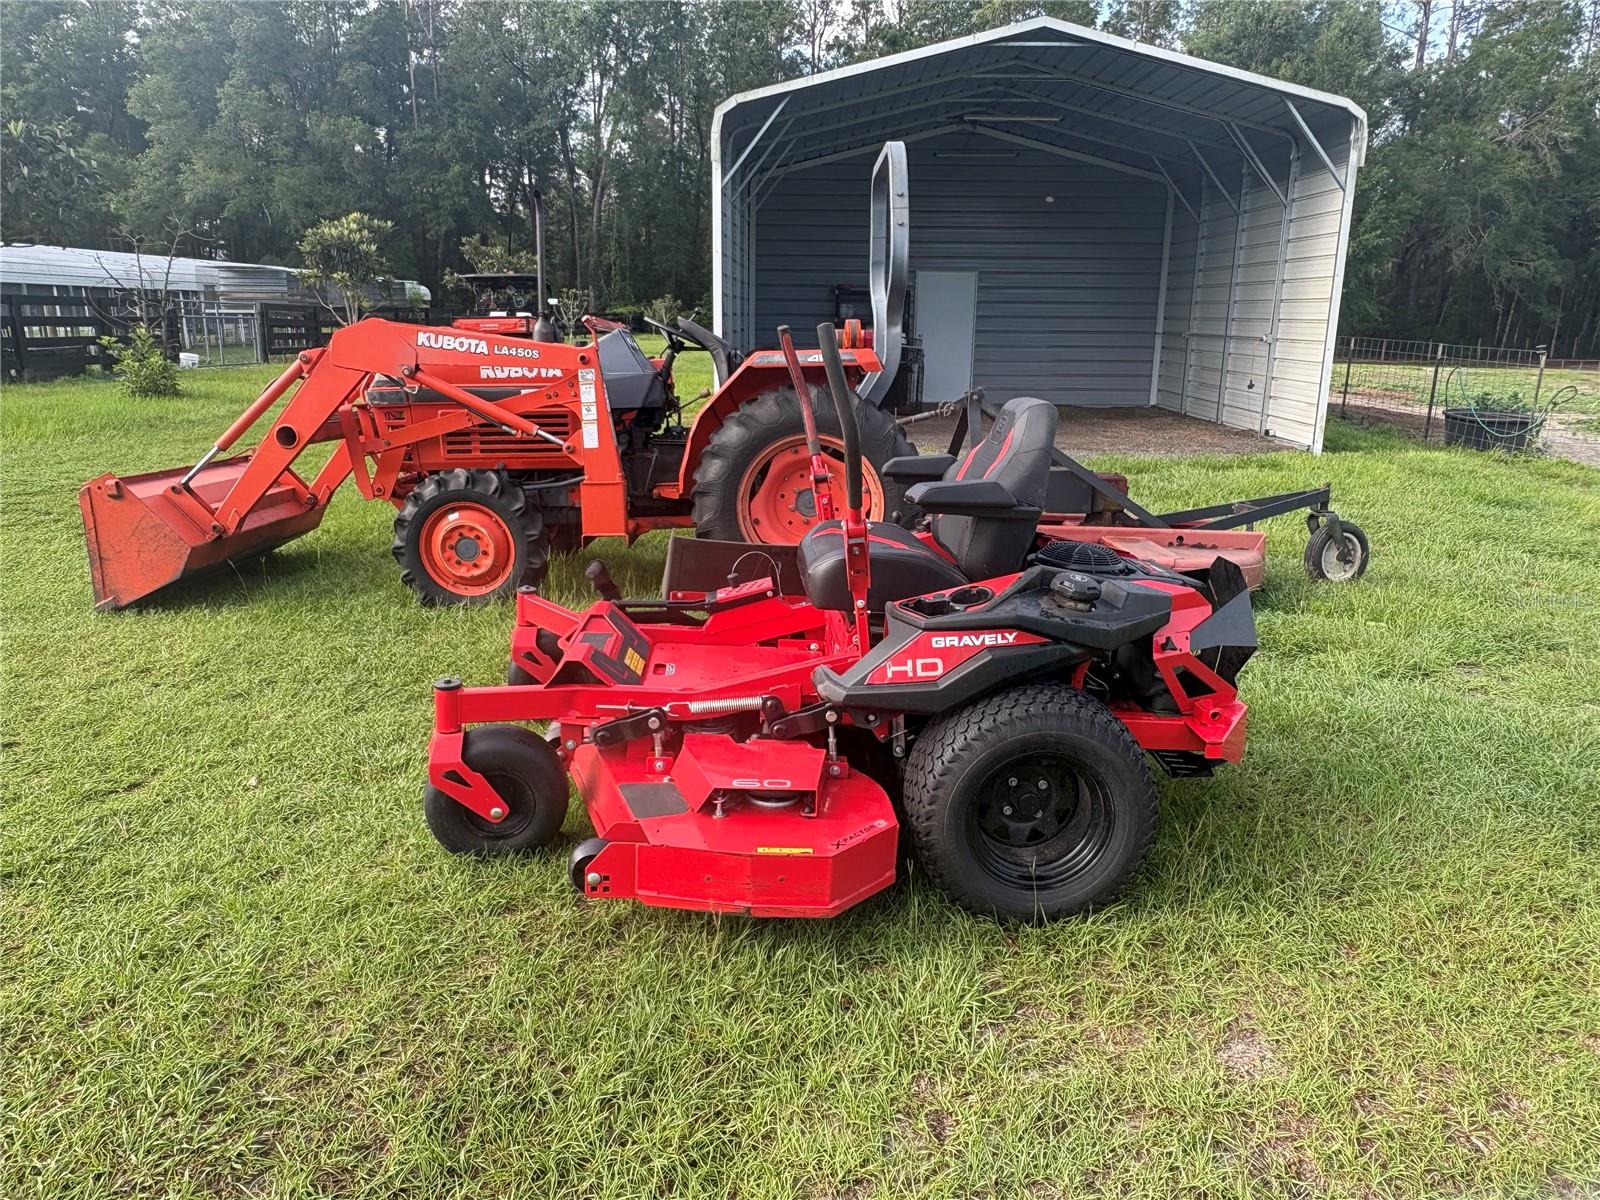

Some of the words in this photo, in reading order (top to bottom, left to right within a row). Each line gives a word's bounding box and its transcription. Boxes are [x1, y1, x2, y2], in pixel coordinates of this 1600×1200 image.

[417, 331, 489, 355] KUBOTA
[494, 344, 540, 358] LA450S
[932, 632, 1018, 649] GRAVELY
[886, 657, 943, 679] HD
[732, 778, 792, 788] 60
